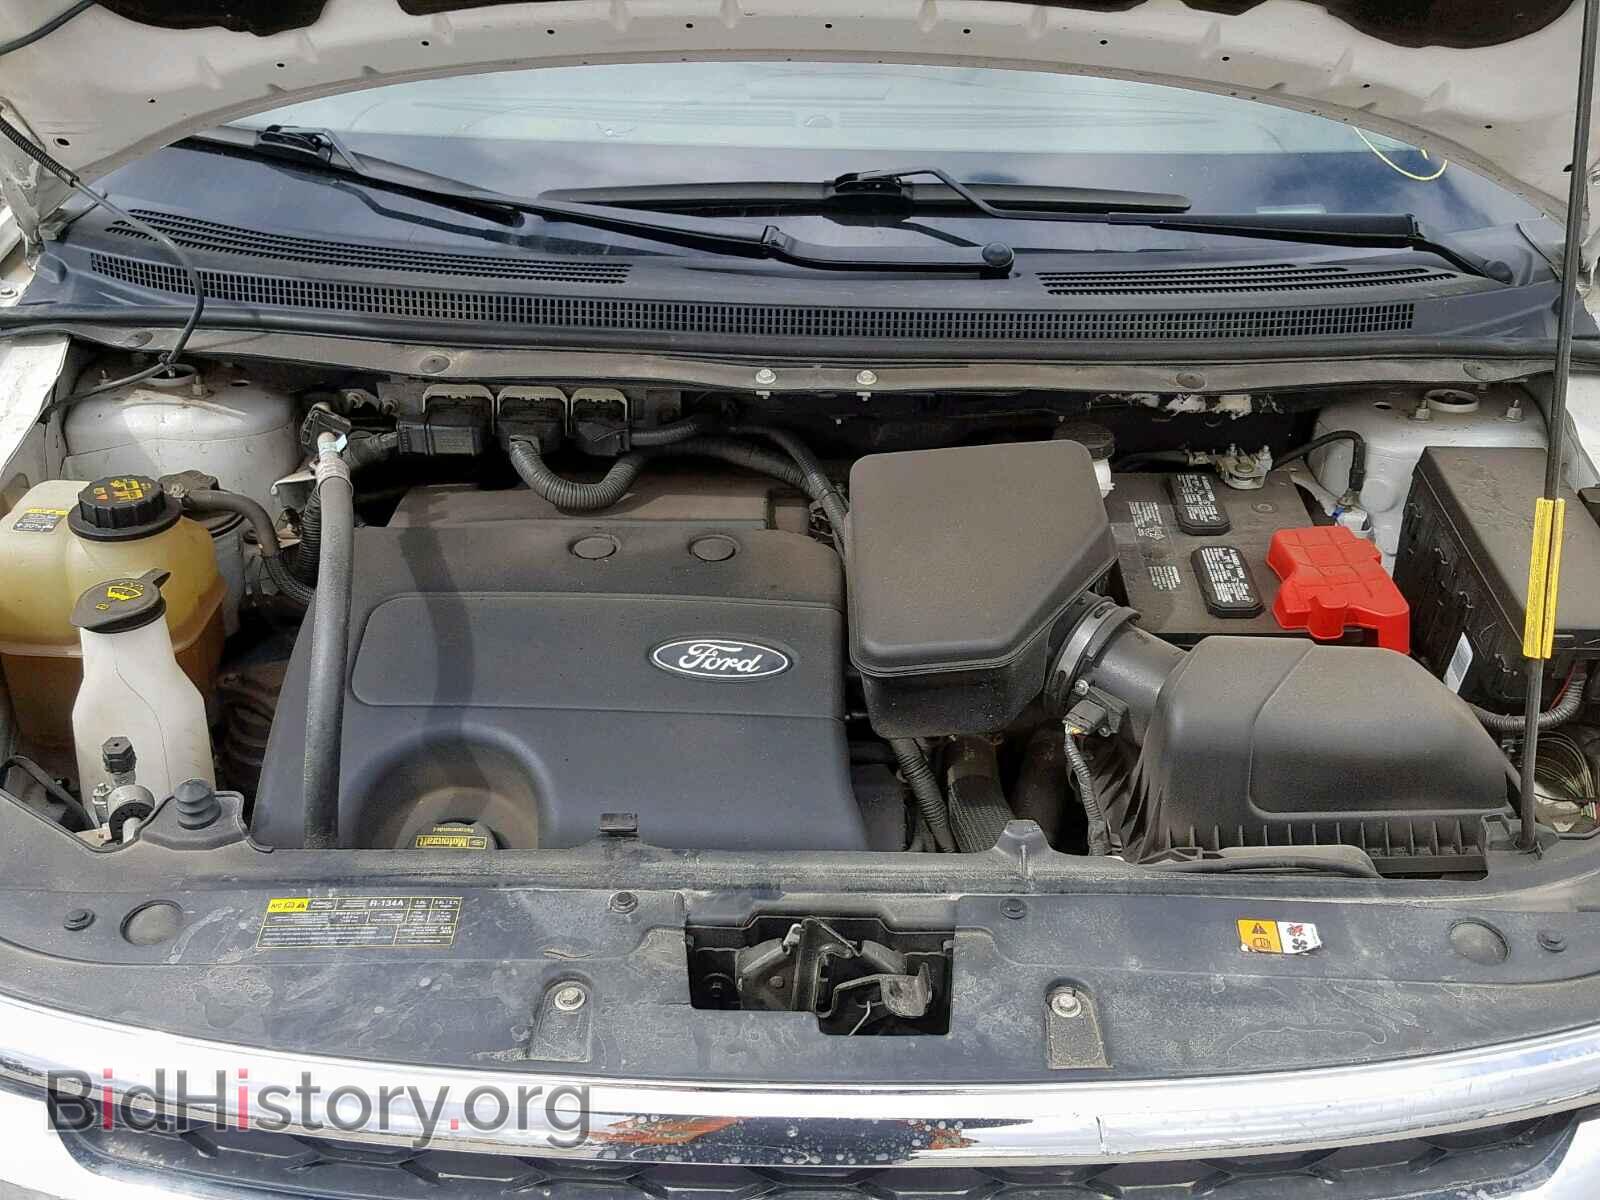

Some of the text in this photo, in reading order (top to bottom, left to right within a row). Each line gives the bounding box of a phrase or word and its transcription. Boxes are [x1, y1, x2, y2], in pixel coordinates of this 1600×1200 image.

[678, 643, 763, 673] Ford
[418, 836, 467, 847] Motorcraft
[369, 899, 404, 907] R-134A
